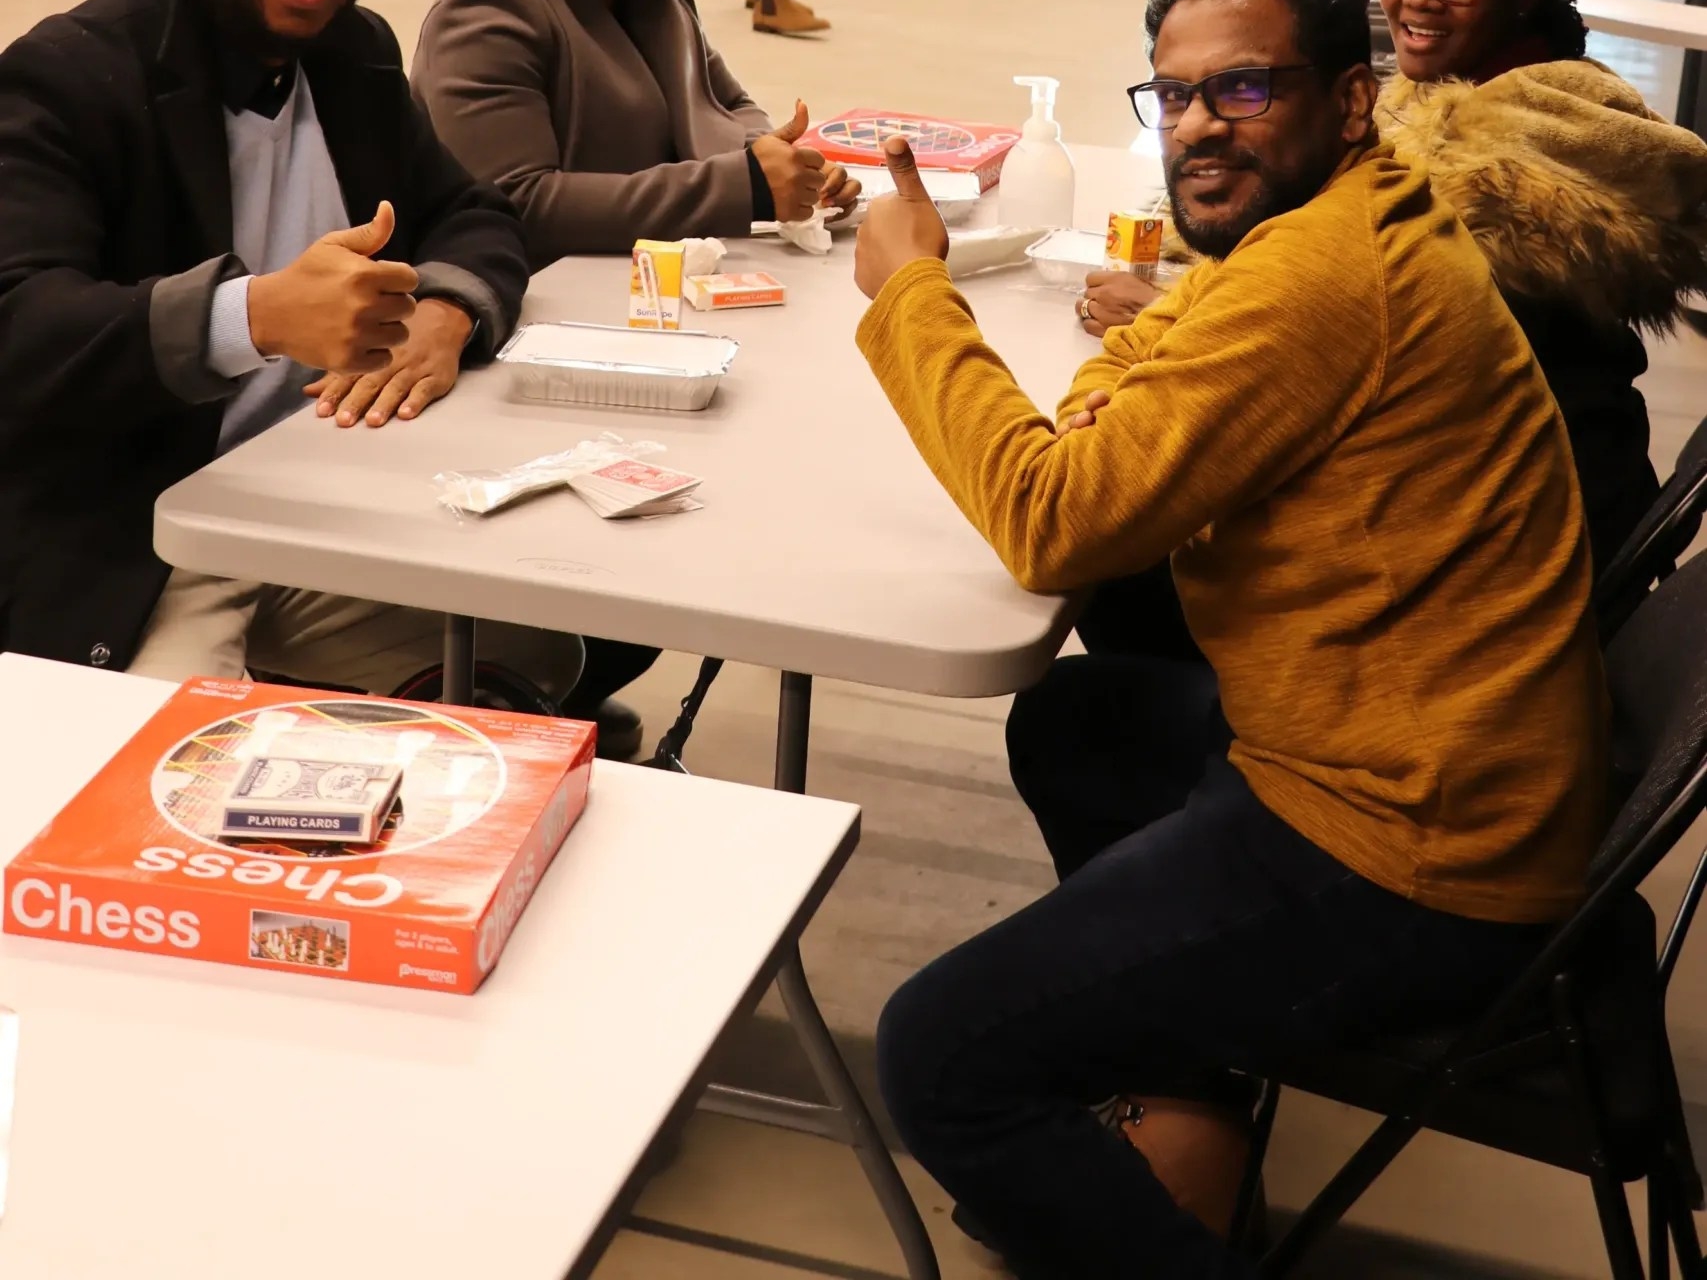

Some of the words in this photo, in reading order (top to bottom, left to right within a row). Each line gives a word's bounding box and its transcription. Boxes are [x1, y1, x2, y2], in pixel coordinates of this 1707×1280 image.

[247, 815, 298, 827] PLAYING
[300, 817, 340, 829] CARDS
[133, 846, 404, 907] Chess
[11, 878, 201, 949] Chess
